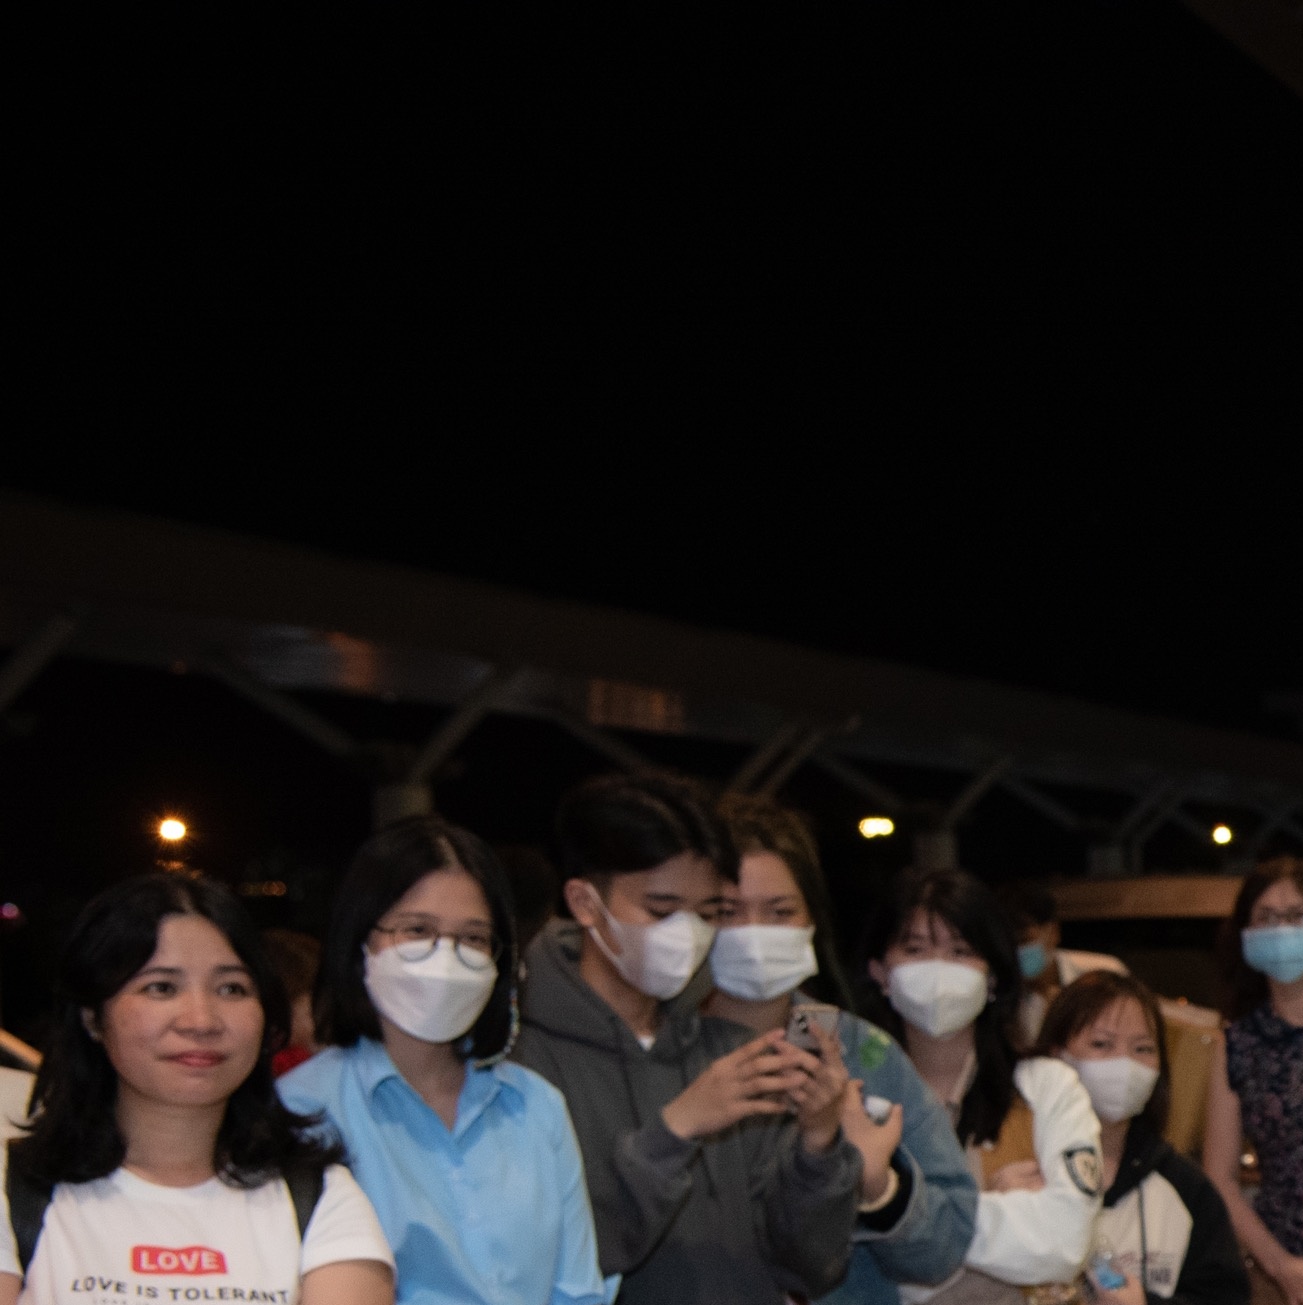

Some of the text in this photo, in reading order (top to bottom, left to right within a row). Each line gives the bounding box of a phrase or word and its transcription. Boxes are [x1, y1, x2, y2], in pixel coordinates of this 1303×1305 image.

[138, 1249, 219, 1272] LOVE
[71, 1276, 290, 1304] LOVE IS TOLERANT
